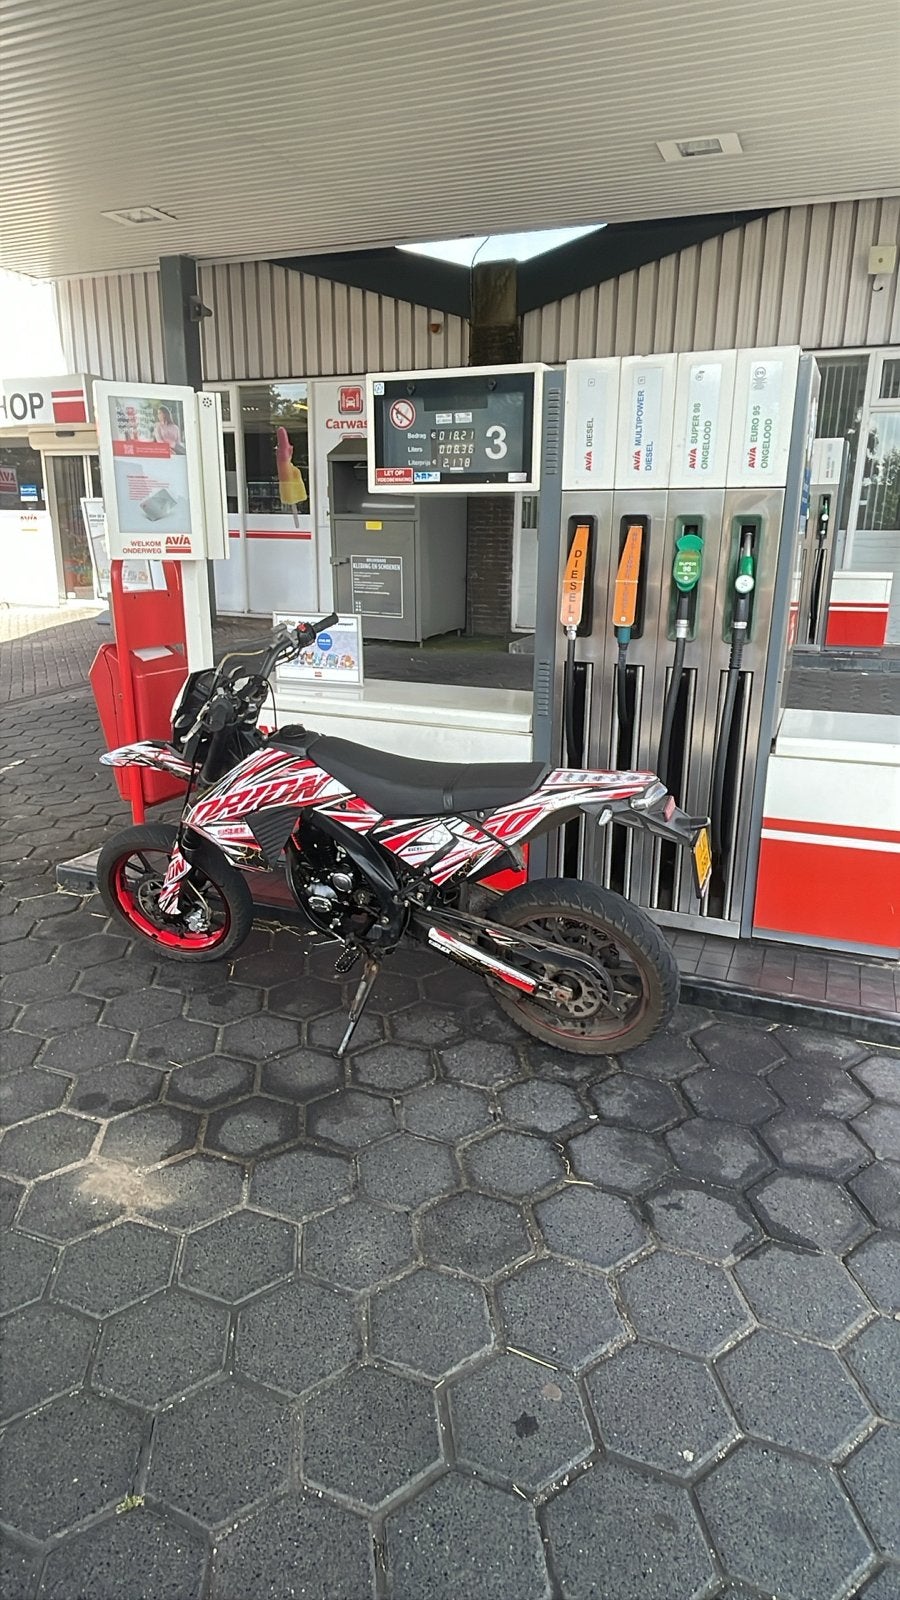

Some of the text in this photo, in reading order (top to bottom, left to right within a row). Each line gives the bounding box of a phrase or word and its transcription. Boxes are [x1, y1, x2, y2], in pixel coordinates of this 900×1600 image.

[0, 392, 44, 421] HOP
[326, 418, 368, 429] Carwas
[632, 390, 645, 471] AVIA MULTIPOWER
[407, 432, 427, 440] Bedrag
[485, 425, 508, 460] 3
[584, 417, 594, 471] AVIA DIESEL
[645, 441, 654, 471] DIESEL
[688, 402, 701, 469] AVIA SUPER 98
[701, 420, 712, 470] ONGELOOD
[747, 405, 761, 469] AVIA EURO 95
[761, 418, 773, 469] ONGELOOD
[165, 534, 191, 545] AVIA
[568, 549, 582, 614] DIESEL
